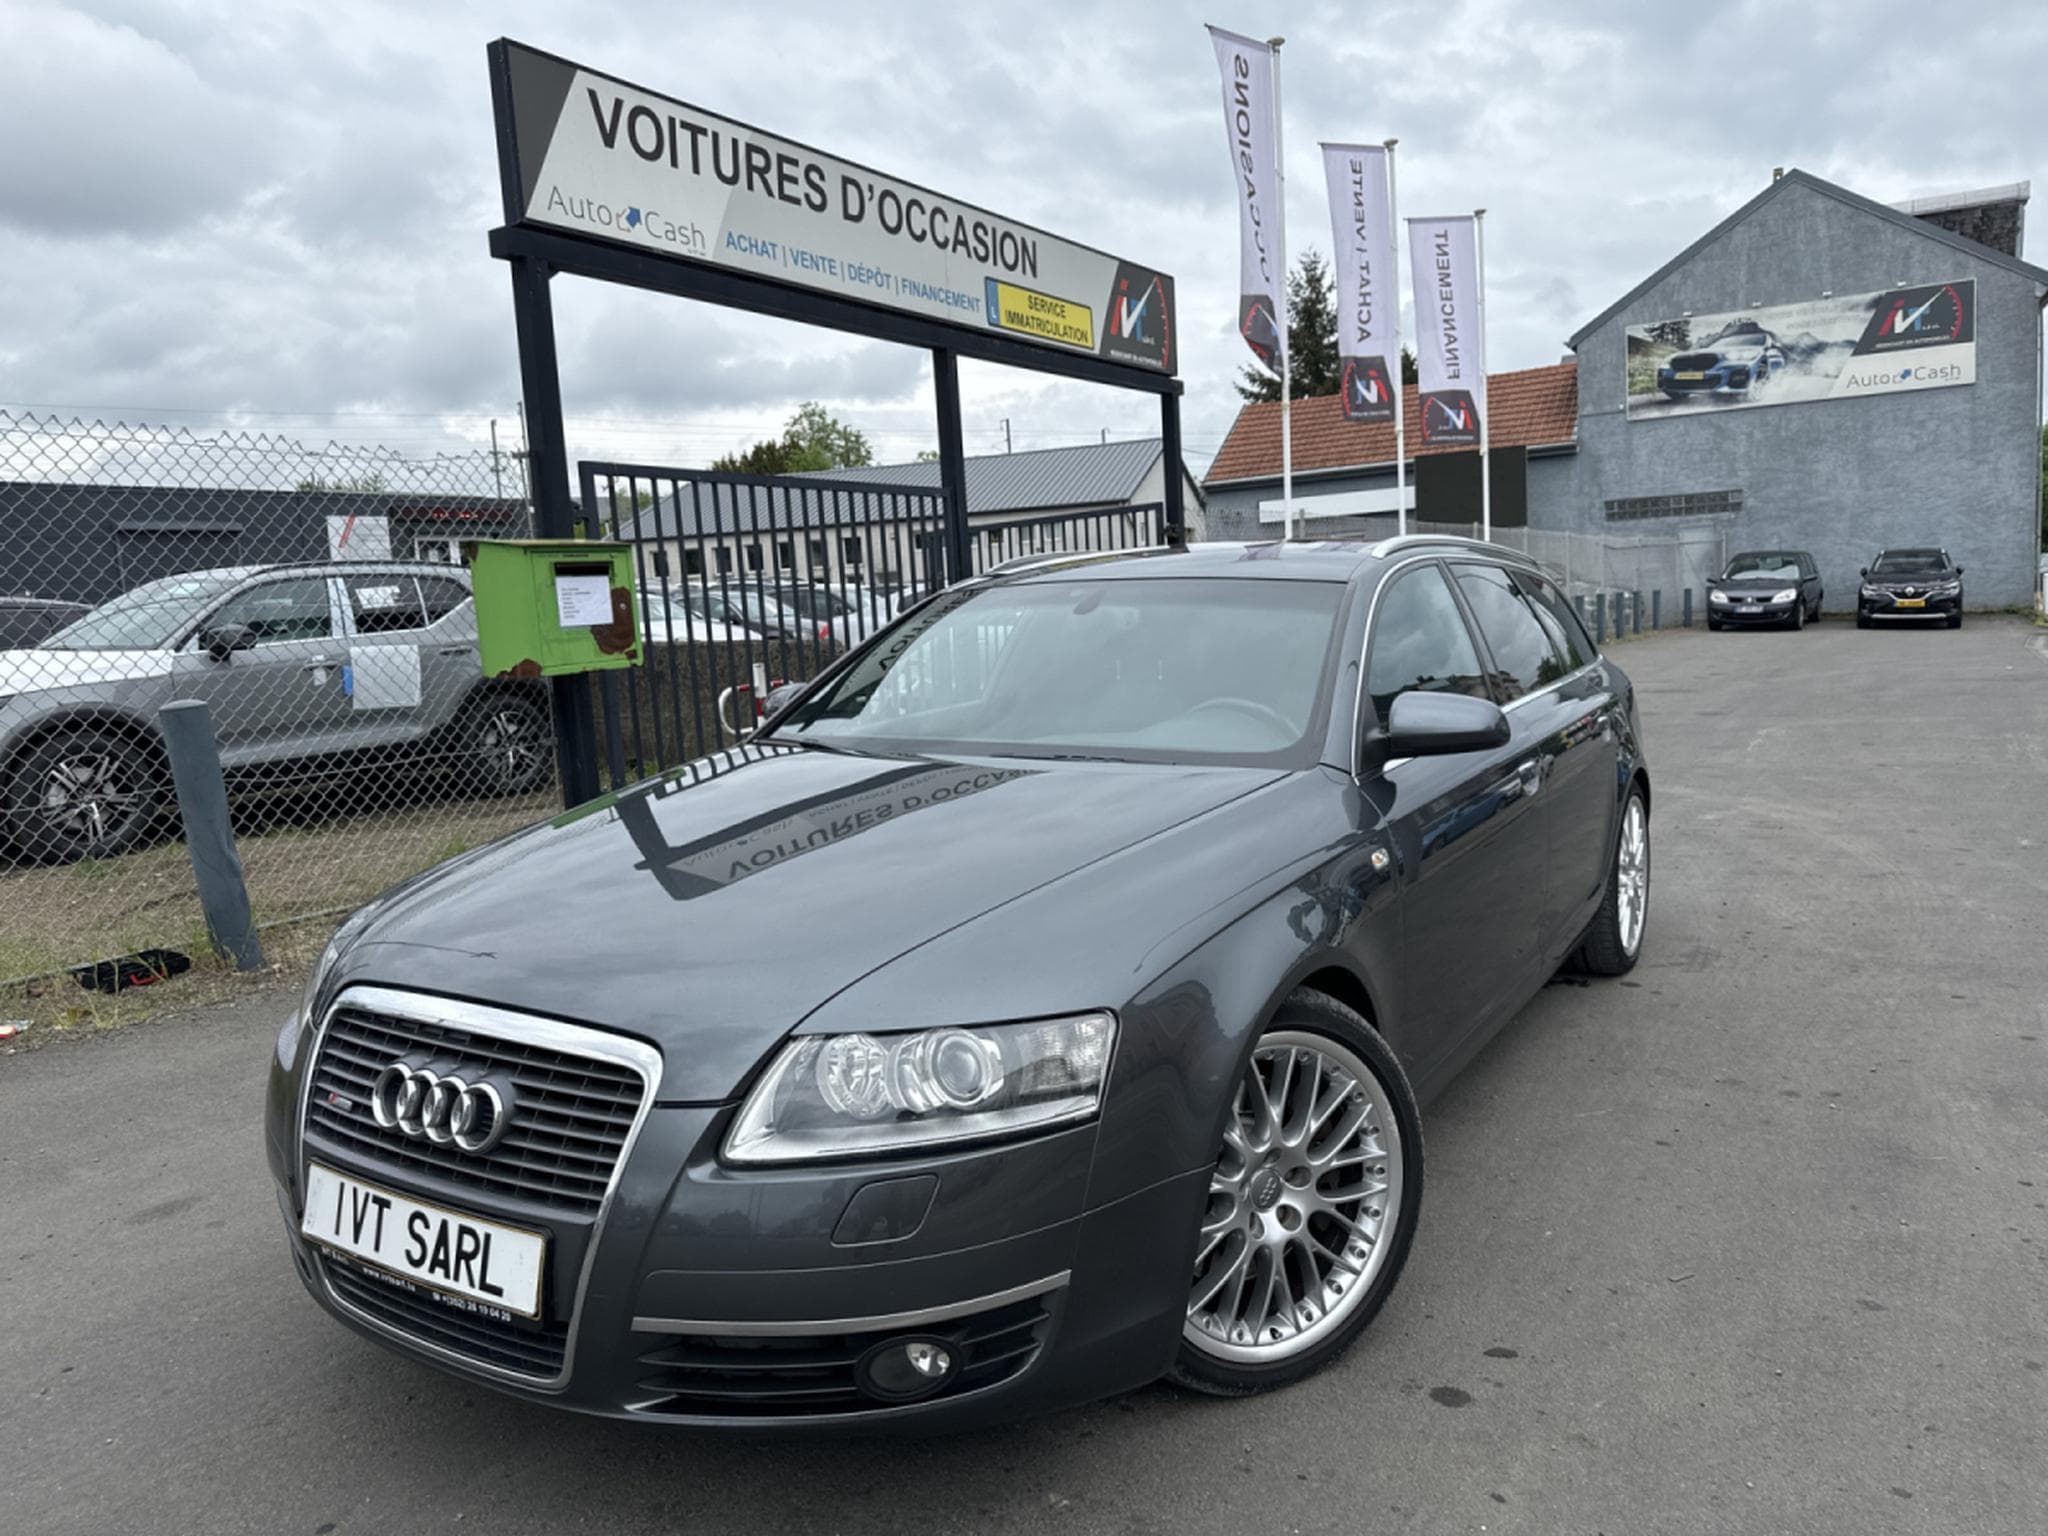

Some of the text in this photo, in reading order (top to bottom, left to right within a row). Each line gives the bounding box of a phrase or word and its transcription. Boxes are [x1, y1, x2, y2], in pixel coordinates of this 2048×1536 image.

[586, 87, 1039, 279] VOITURES D'OCCASION
[547, 185, 707, 250] Auto Cash
[725, 230, 983, 314] ACHAT VENTE DÉPÔT FINANCEMENT
[1004, 309, 1090, 344] IMMATRICULATION
[1027, 294, 1067, 320] SERVICE
[1845, 364, 1962, 389] Auto Cash
[334, 1181, 505, 1298] IVT SARL
